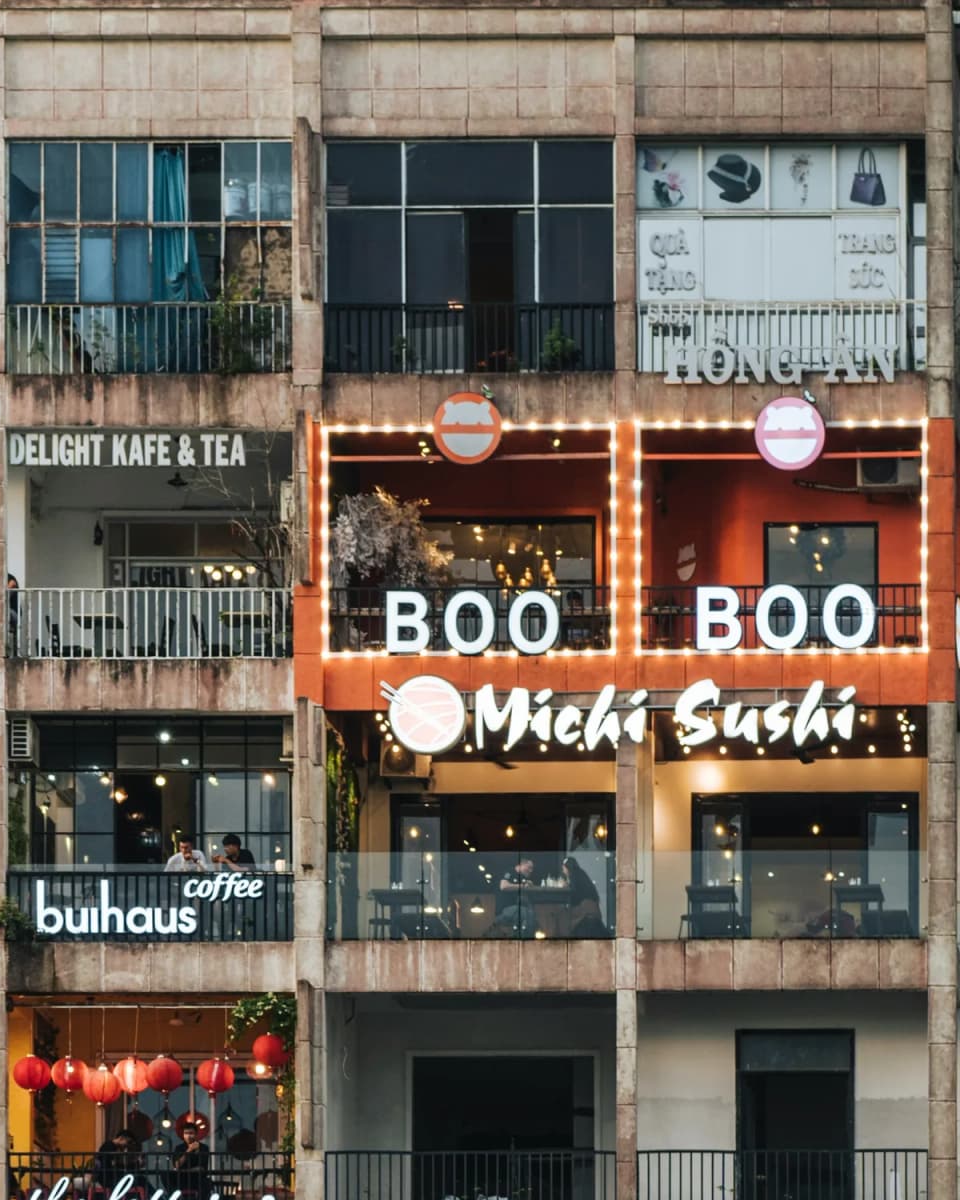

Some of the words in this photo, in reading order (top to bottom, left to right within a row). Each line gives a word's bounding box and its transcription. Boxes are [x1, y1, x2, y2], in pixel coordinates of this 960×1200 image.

[838, 232, 898, 255] TRANG
[9, 433, 105, 467] DELIGHT
[111, 433, 172, 467] KAFE
[177, 433, 196, 467] &
[200, 433, 247, 467] TEA
[385, 590, 560, 655] BOO
[696, 583, 875, 650] BOO
[475, 682, 649, 751] Michi
[673, 678, 857, 746] Sushi
[183, 872, 265, 901] coffee
